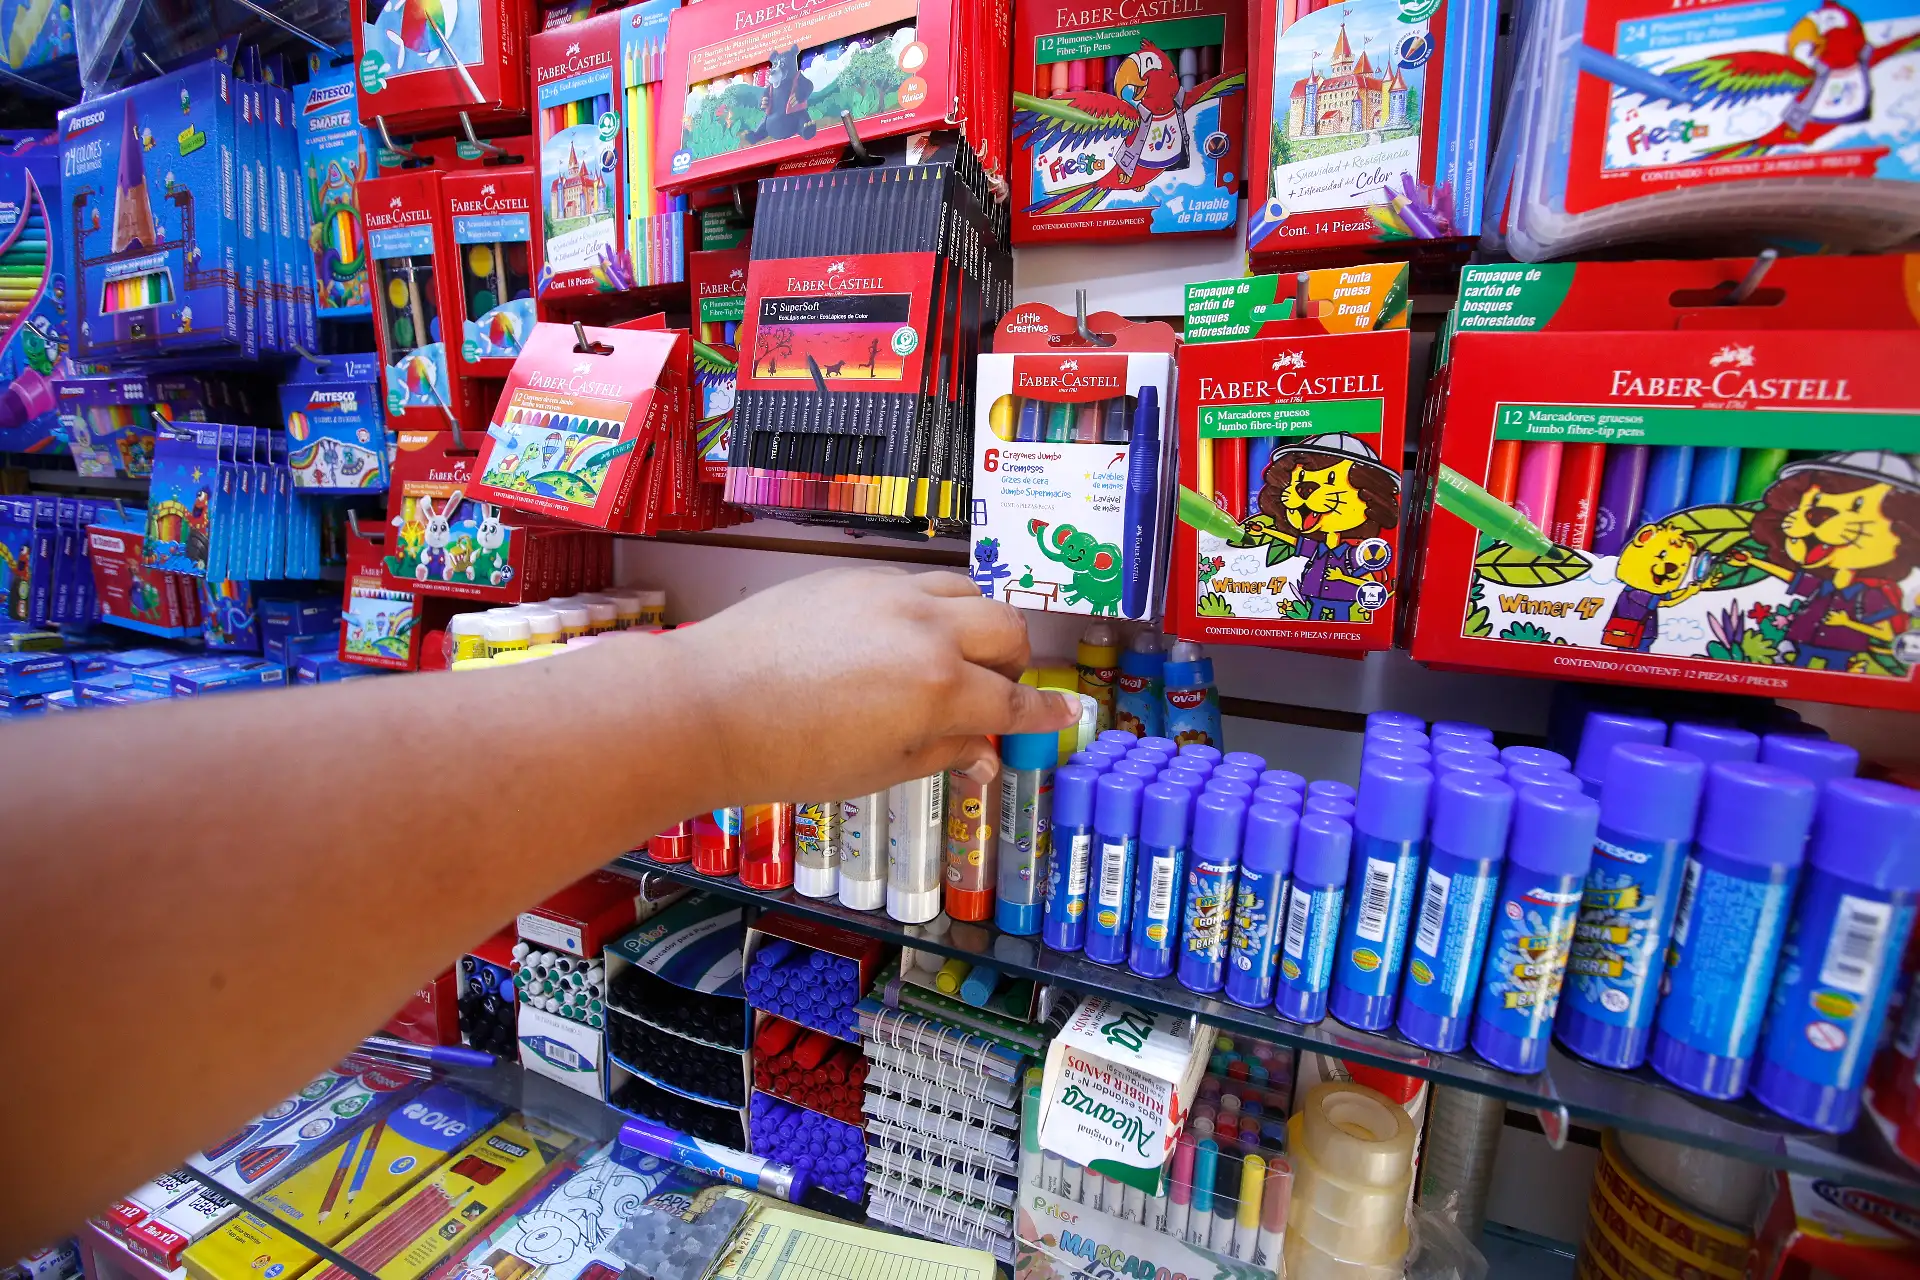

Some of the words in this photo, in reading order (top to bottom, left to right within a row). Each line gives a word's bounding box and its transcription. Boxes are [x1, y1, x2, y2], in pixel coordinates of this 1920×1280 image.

[632, 16, 641, 26] +6
[1057, 0, 1203, 28] FABER-CASTELL
[693, 53, 702, 64] 12
[704, 48, 723, 58] Barras
[733, 35, 760, 49] Plastilina
[761, 30, 781, 43] Jumbo
[794, 15, 828, 30] Triangular
[828, 10, 843, 20] para
[1041, 39, 1054, 51] 12
[1057, 29, 1140, 45] Plumones-Marcadores
[1057, 44, 1091, 56] Fibre-Tip
[1093, 42, 1111, 51] Pens
[537, 51, 612, 82] FABER-CASTELL
[308, 84, 351, 102] ARTESCO
[908, 82, 918, 92] No
[902, 92, 924, 104] Tóxica
[68, 111, 105, 132] ARTESCO
[309, 110, 352, 132] SMARTZ
[1627, 119, 1709, 155] Fiesta
[779, 160, 808, 171] Colores
[808, 156, 836, 167] Cálidos
[1050, 152, 1106, 182] Fiesta
[451, 196, 529, 212] FABER-CASTELL
[1188, 198, 1229, 211] Lavable
[365, 208, 432, 227] FABER-CASTELL
[1177, 212, 1190, 223] de
[1192, 212, 1201, 222] la
[1203, 212, 1229, 225] ropa
[1279, 225, 1310, 237] Cont.
[1315, 222, 1329, 234] 14
[551, 280, 566, 290] Cont.
[568, 279, 575, 288] 18
[576, 276, 595, 286] Piezas
[787, 275, 884, 292] FABER-CASTELL
[1339, 272, 1371, 285] Punta
[1465, 268, 1523, 285] Empaque
[1525, 268, 1541, 282] de
[1189, 285, 1234, 299] Empaque
[1236, 283, 1250, 294] de
[1333, 285, 1371, 300] gruesa
[1464, 283, 1503, 298] cartón
[1505, 283, 1521, 297] de
[764, 302, 777, 316] 15
[779, 302, 820, 313] SuperSoft
[1188, 300, 1220, 312] cartón
[1221, 299, 1235, 309] de
[1337, 302, 1371, 316] Broad
[1462, 298, 1513, 314] bosques
[1016, 312, 1041, 325] Little
[1188, 312, 1229, 325] bosques
[1355, 315, 1370, 329] tip
[1460, 313, 1536, 328] reforestados
[1006, 324, 1049, 334] Creatives
[1188, 324, 1250, 338] reforestados
[345, 360, 355, 378] 12
[527, 371, 624, 398] FABER-CASTELL
[1019, 372, 1120, 388] FABER-CASTELL
[1199, 371, 1384, 400] FABER-CASTELL
[1609, 369, 1852, 402] FABER-CASTELL
[309, 390, 355, 402] ARTESCO
[1204, 412, 1213, 424] 6
[1217, 410, 1271, 420] Marcadores
[1273, 408, 1310, 420] gruesos
[1503, 410, 1523, 425] 12
[1528, 410, 1596, 423] Marcadores
[1598, 412, 1644, 425] gruesos
[1216, 421, 1248, 432] Jumbo
[1249, 419, 1288, 431] fibre-tip
[1290, 420, 1313, 431] pens
[1525, 422, 1565, 435] Jumbo
[1567, 424, 1615, 438] fibre-tip
[1617, 426, 1645, 438] pens
[984, 448, 1000, 473] 6
[1002, 451, 1036, 461] Crayones
[1038, 451, 1062, 460] Jumbo
[1001, 462, 1044, 474] Cremosos
[1001, 475, 1022, 484] Gizes
[1022, 476, 1031, 484] de
[1032, 476, 1049, 486] cera
[1092, 471, 1125, 481] Lavables
[1001, 487, 1025, 496] Jumbo
[1025, 487, 1072, 498] Supermacios
[1101, 482, 1124, 490] manos
[1093, 494, 1121, 503] Lavável
[1102, 504, 1120, 513] mãos
[1211, 577, 1267, 595] Winner
[1267, 576, 1287, 595] 47
[1498, 593, 1574, 618] Winner
[1574, 597, 1605, 620] 47
[1205, 626, 1250, 636] CONTENIDO
[1254, 628, 1293, 638] CONTENT:
[1294, 630, 1299, 638] 6
[1300, 630, 1328, 640] PIEZAS
[1333, 631, 1361, 641] PIECES
[1554, 656, 1618, 671] CONTENIDO
[1624, 663, 1681, 678] CONTENT:
[1684, 669, 1696, 679] 12
[1697, 671, 1739, 683] PIEZAS
[1746, 675, 1788, 689] PIECES
[1120, 677, 1142, 689] oval
[1172, 692, 1201, 703] oval
[624, 924, 668, 953] Prior
[646, 941, 677, 965] Marcador
[677, 931, 694, 943] para
[1064, 1069, 1075, 1081] 18
[1067, 1055, 1111, 1085] BANDS
[1078, 1078, 1090, 1088] N°
[1092, 1083, 1136, 1109] estándar
[1114, 1078, 1164, 1116] RUBBER
[1061, 1084, 1155, 1158] Alleanza
[1138, 1107, 1162, 1127] Ligas
[1077, 1124, 1113, 1146] Original
[1114, 1141, 1125, 1152] La
[201, 1187, 231, 1208] BLACK
[190, 1199, 219, 1216] PEPS
[1033, 1196, 1079, 1225] Prior
